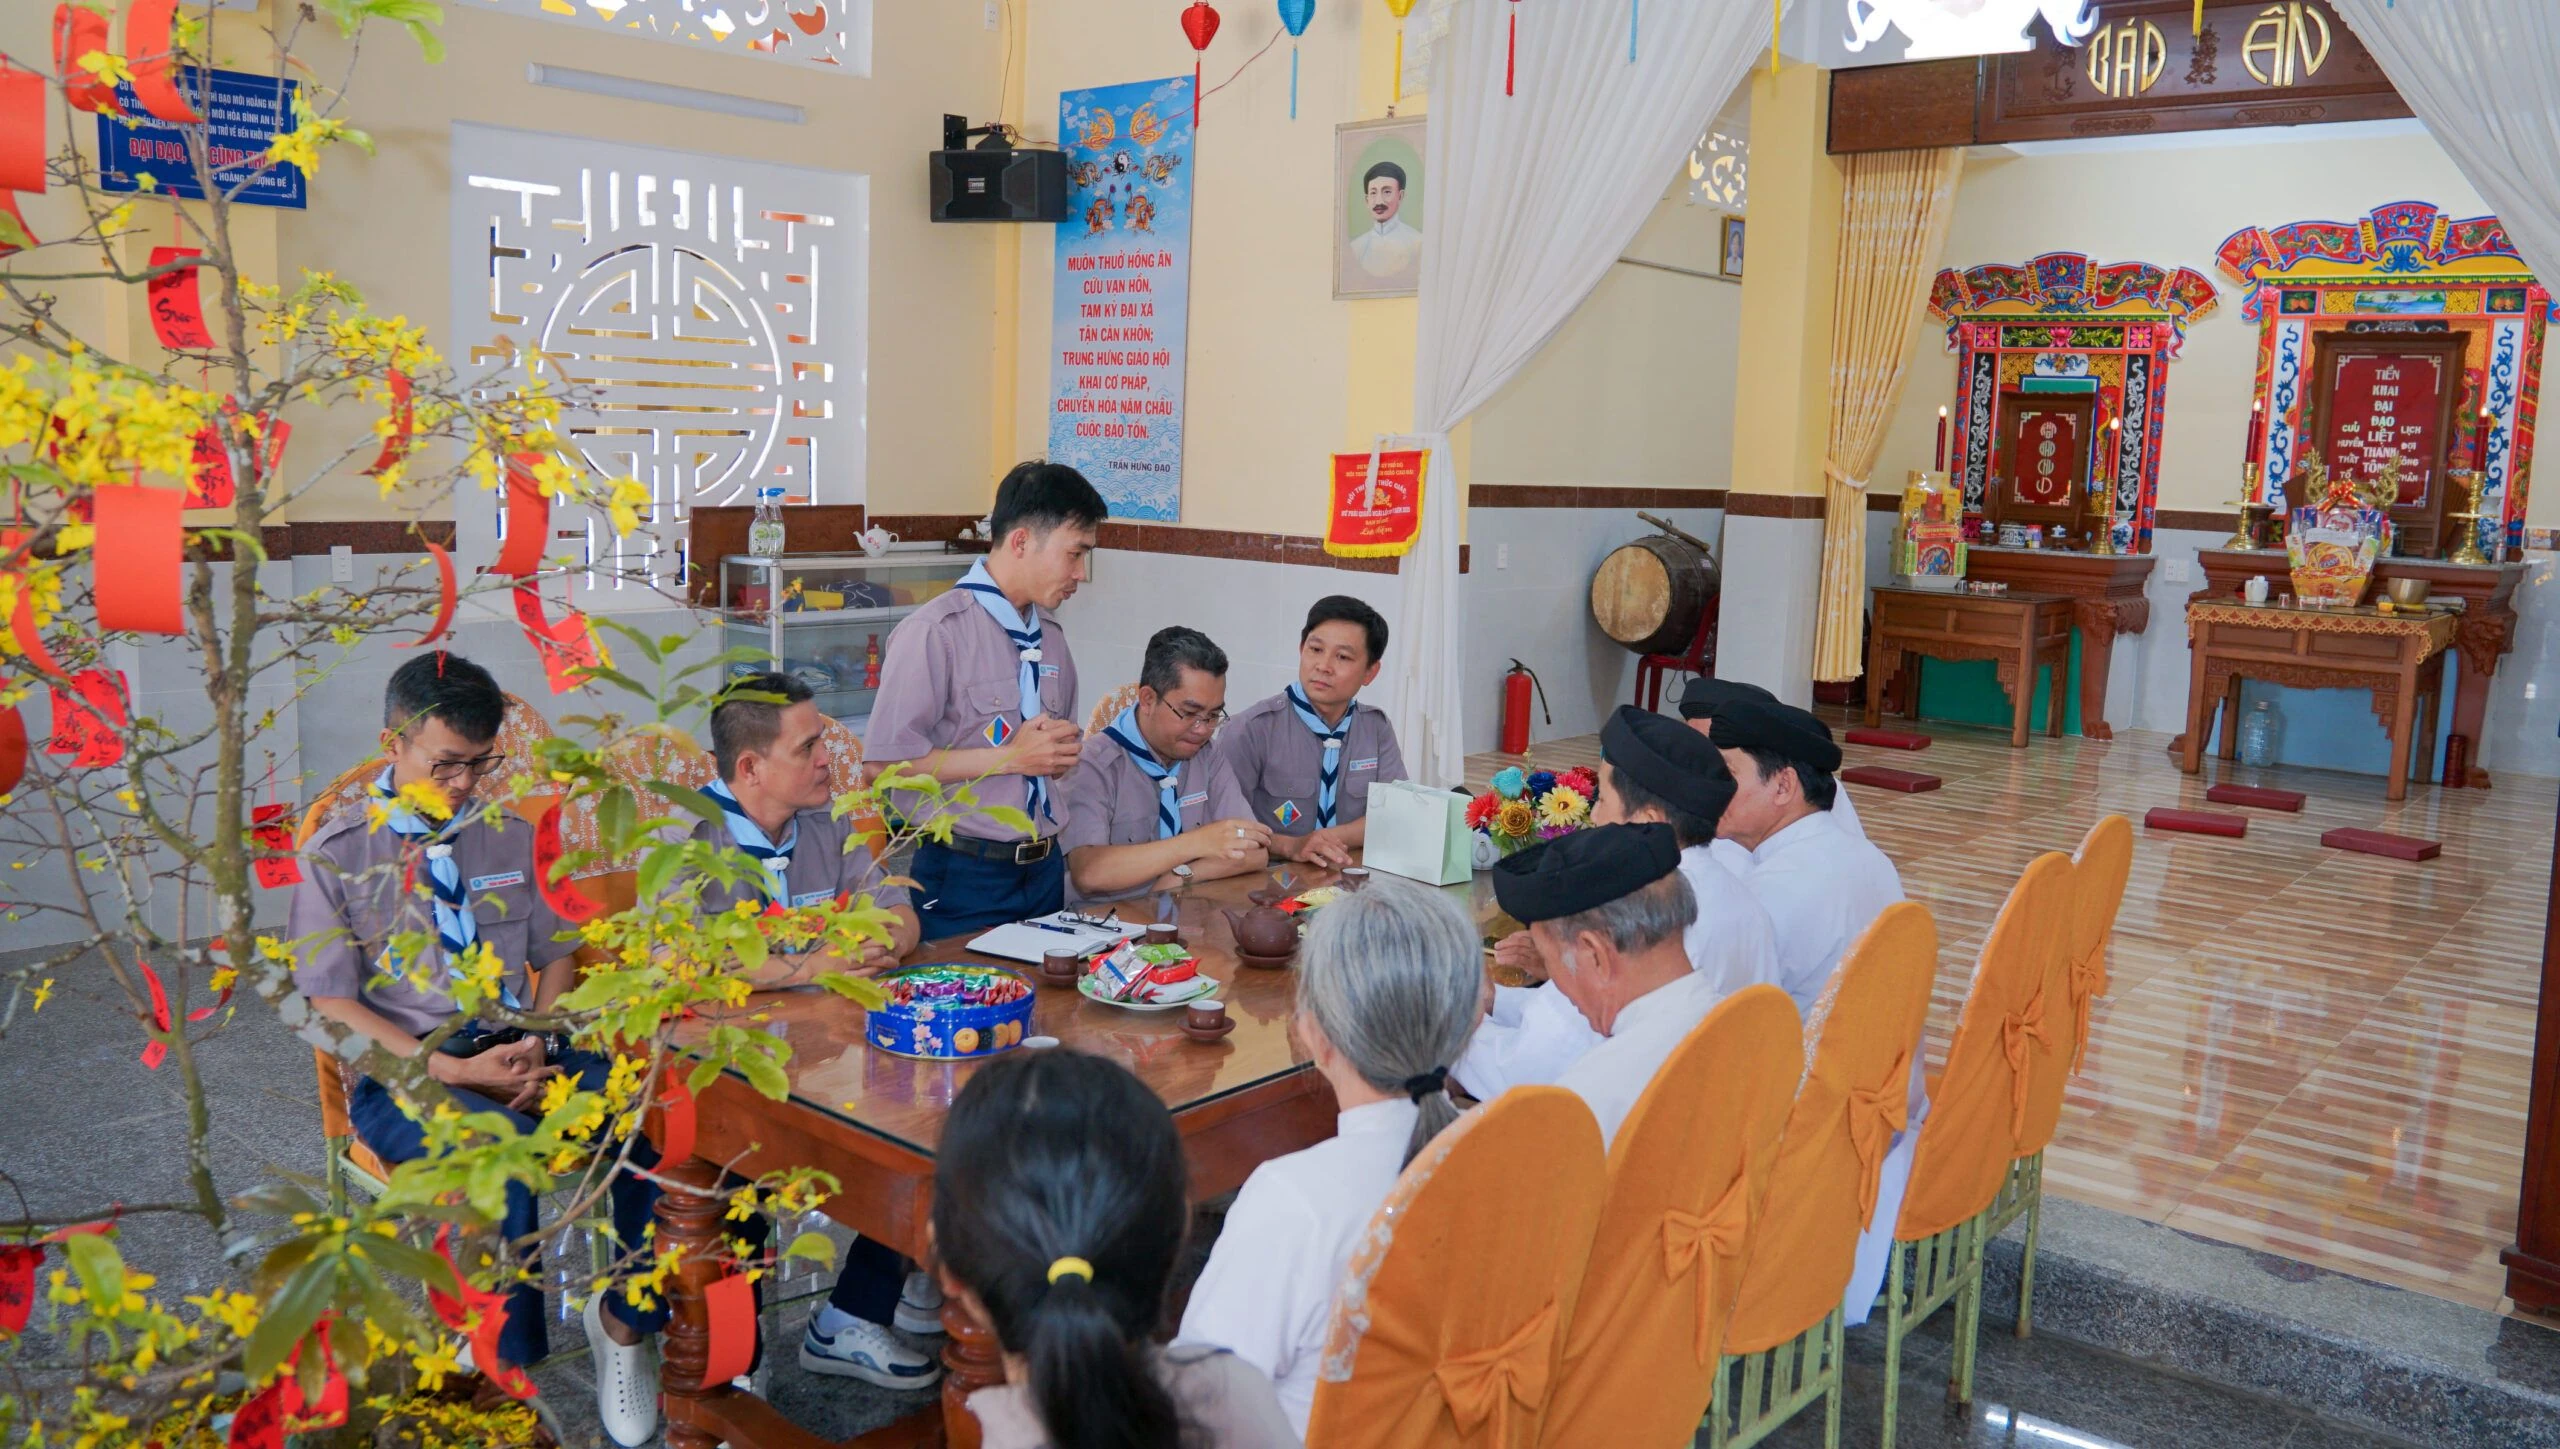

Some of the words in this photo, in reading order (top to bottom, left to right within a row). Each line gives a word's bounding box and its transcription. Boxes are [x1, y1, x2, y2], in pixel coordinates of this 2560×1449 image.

[2242, 2, 2331, 87] ÂN
[119, 97, 129, 108] CÓ
[260, 115, 270, 126] AN
[129, 138, 152, 163] ĐẠI
[156, 141, 187, 165] ĐẠO,
[1067, 253, 1096, 271] MUÔN
[1098, 249, 1126, 270] THUỞ
[1127, 248, 1155, 269] HỒNG
[1157, 249, 1172, 267] ÂN
[1084, 277, 1103, 295] CỨU
[1106, 279, 1125, 296] VẠN
[1080, 303, 1101, 318] TAM
[1120, 303, 1137, 320] ĐẠI
[1079, 324, 1098, 345] TẬN
[1062, 351, 1094, 366] TRUNG
[1096, 349, 1124, 366] HƯNG
[1126, 348, 1149, 366] GIÁO
[1152, 347, 1170, 369] HỘI
[1078, 375, 1102, 390] KHAI
[1104, 373, 1119, 390] CƠ
[1121, 372, 1150, 392] PHÁP,
[2372, 385, 2399, 396] KHAI
[1057, 392, 1095, 413] CHUYỂN
[1097, 396, 1117, 413] HÓA
[1120, 397, 1142, 414] NĂM
[1145, 397, 1172, 416] CHÂU
[2374, 400, 2393, 414] ĐẠI
[1076, 420, 1102, 440] CUỘC
[1104, 418, 1124, 438] BẢO
[2371, 416, 2395, 429] ĐẠO
